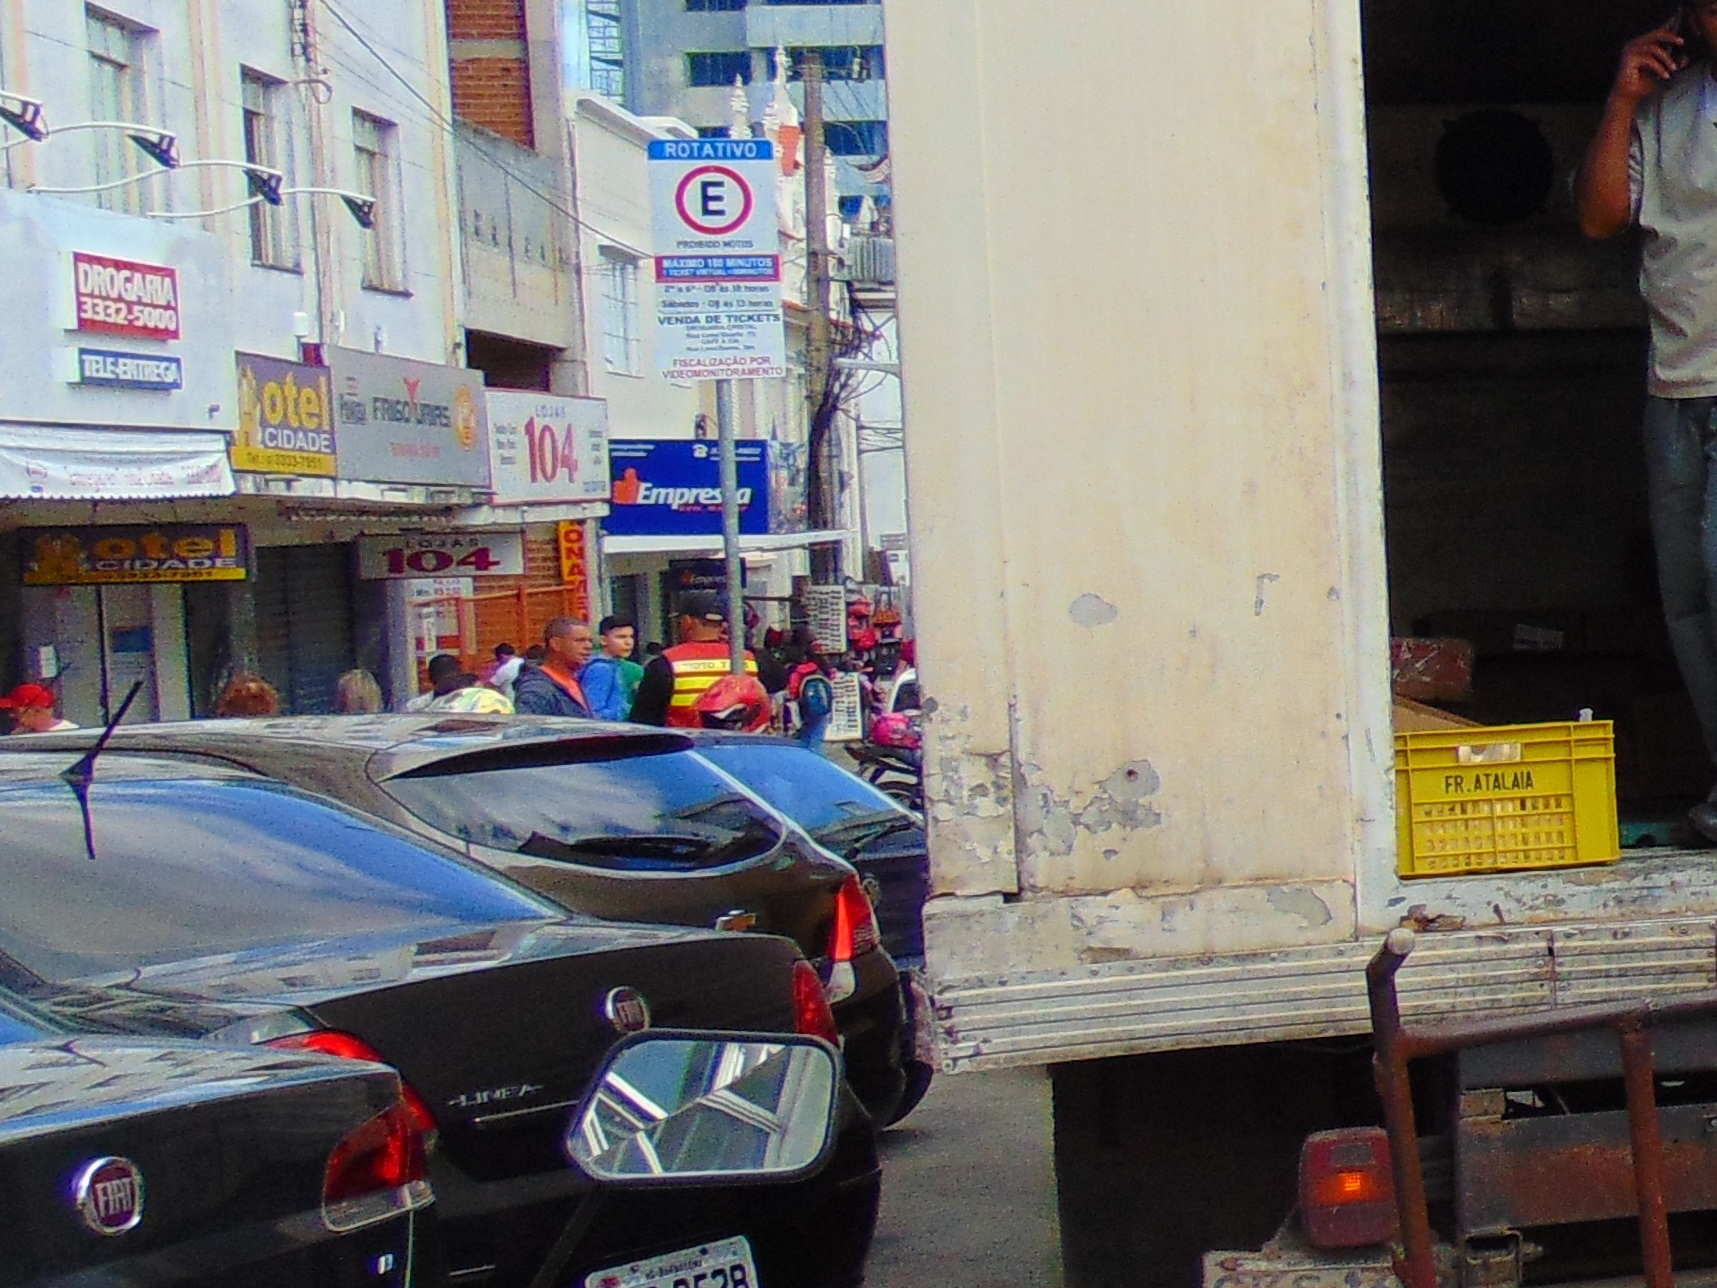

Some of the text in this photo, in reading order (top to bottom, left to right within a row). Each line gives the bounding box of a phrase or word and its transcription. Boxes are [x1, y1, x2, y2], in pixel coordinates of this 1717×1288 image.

[665, 142, 757, 158] ROTATIVO
[701, 180, 727, 216] E
[725, 257, 774, 268] MINUTOS
[77, 261, 176, 308] DROGARIA
[80, 297, 177, 331] 3332-5000
[657, 313, 781, 326] VENDA DE TICKETS
[662, 367, 783, 379] VIDEOMONITORAMENTO
[673, 356, 771, 368] FISCALIZAÇÃO POR
[264, 427, 332, 453] CIDADE
[524, 415, 578, 484] 104
[406, 537, 481, 549] LOJAS
[383, 546, 502, 574] 104
[1444, 770, 1534, 795] FR.ATALAIA
[94, 1177, 134, 1217] FIAT
